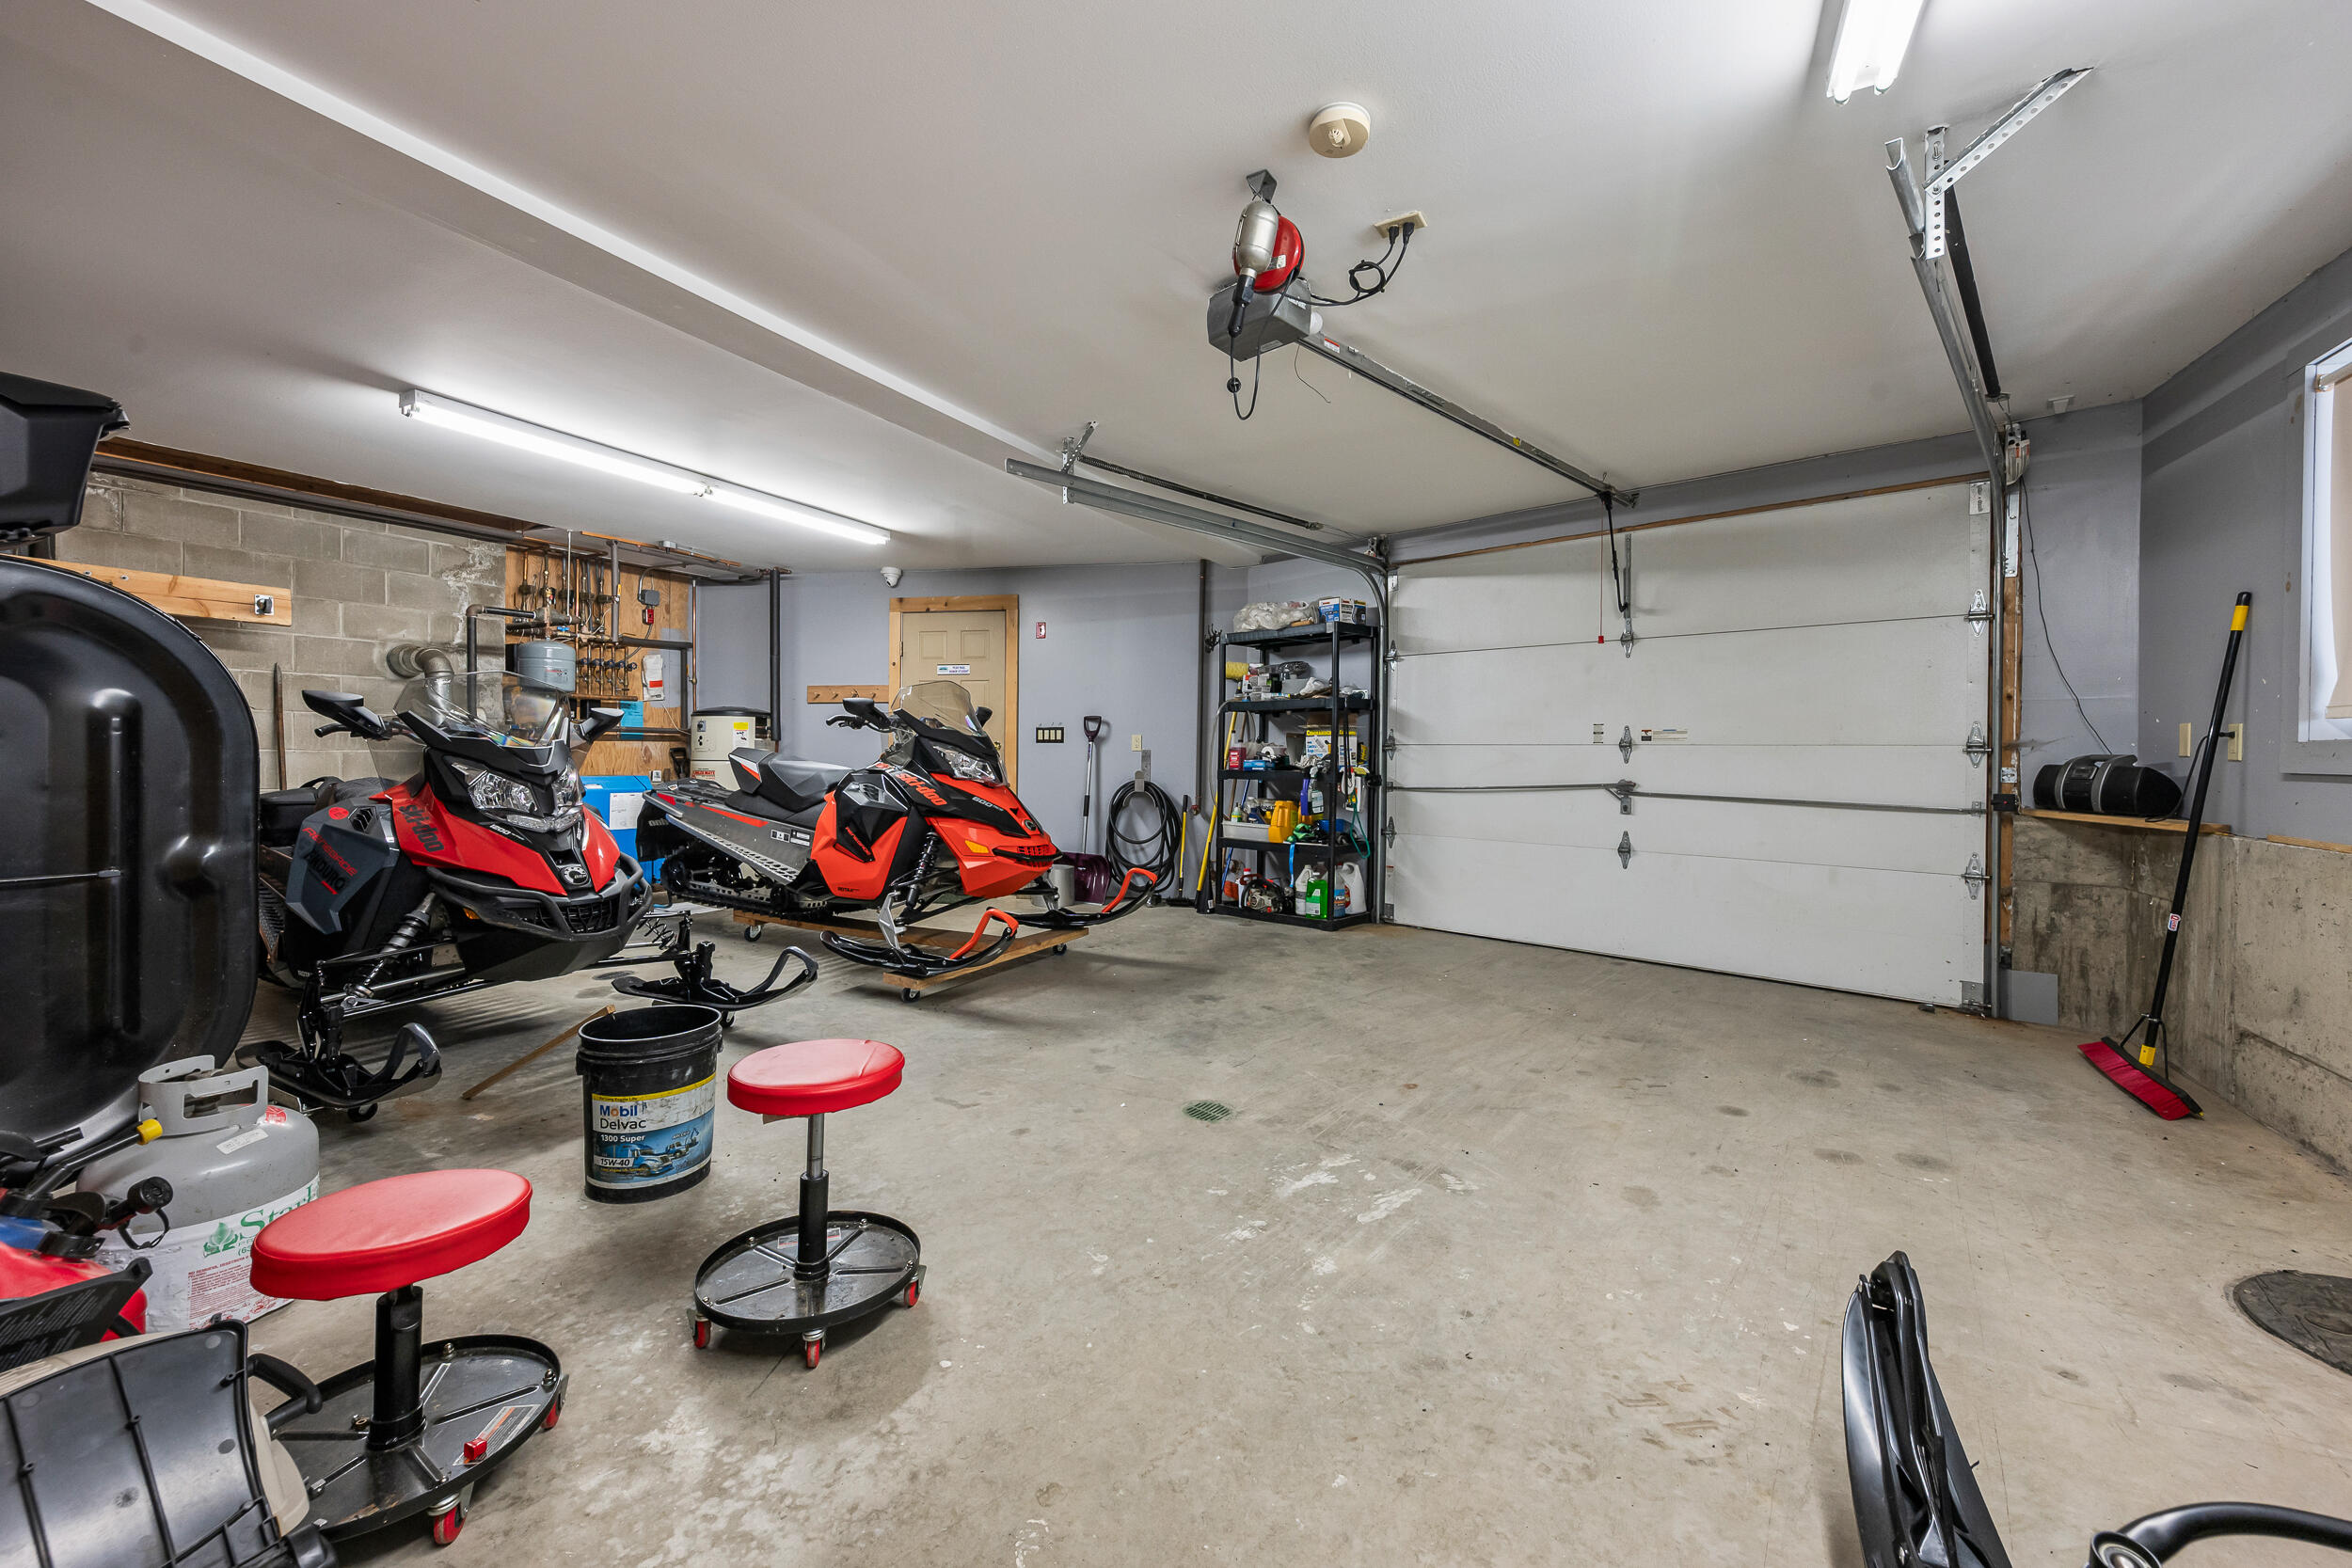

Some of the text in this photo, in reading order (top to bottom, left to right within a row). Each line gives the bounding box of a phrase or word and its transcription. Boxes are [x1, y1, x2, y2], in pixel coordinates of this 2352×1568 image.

[896, 772, 947, 806] ski-doo
[399, 804, 445, 852] ski-doo
[599, 1104, 638, 1117] Mobil
[599, 1117, 647, 1131] Delvac
[620, 1134, 645, 1144] Super
[600, 1158, 630, 1166] 15W-40
